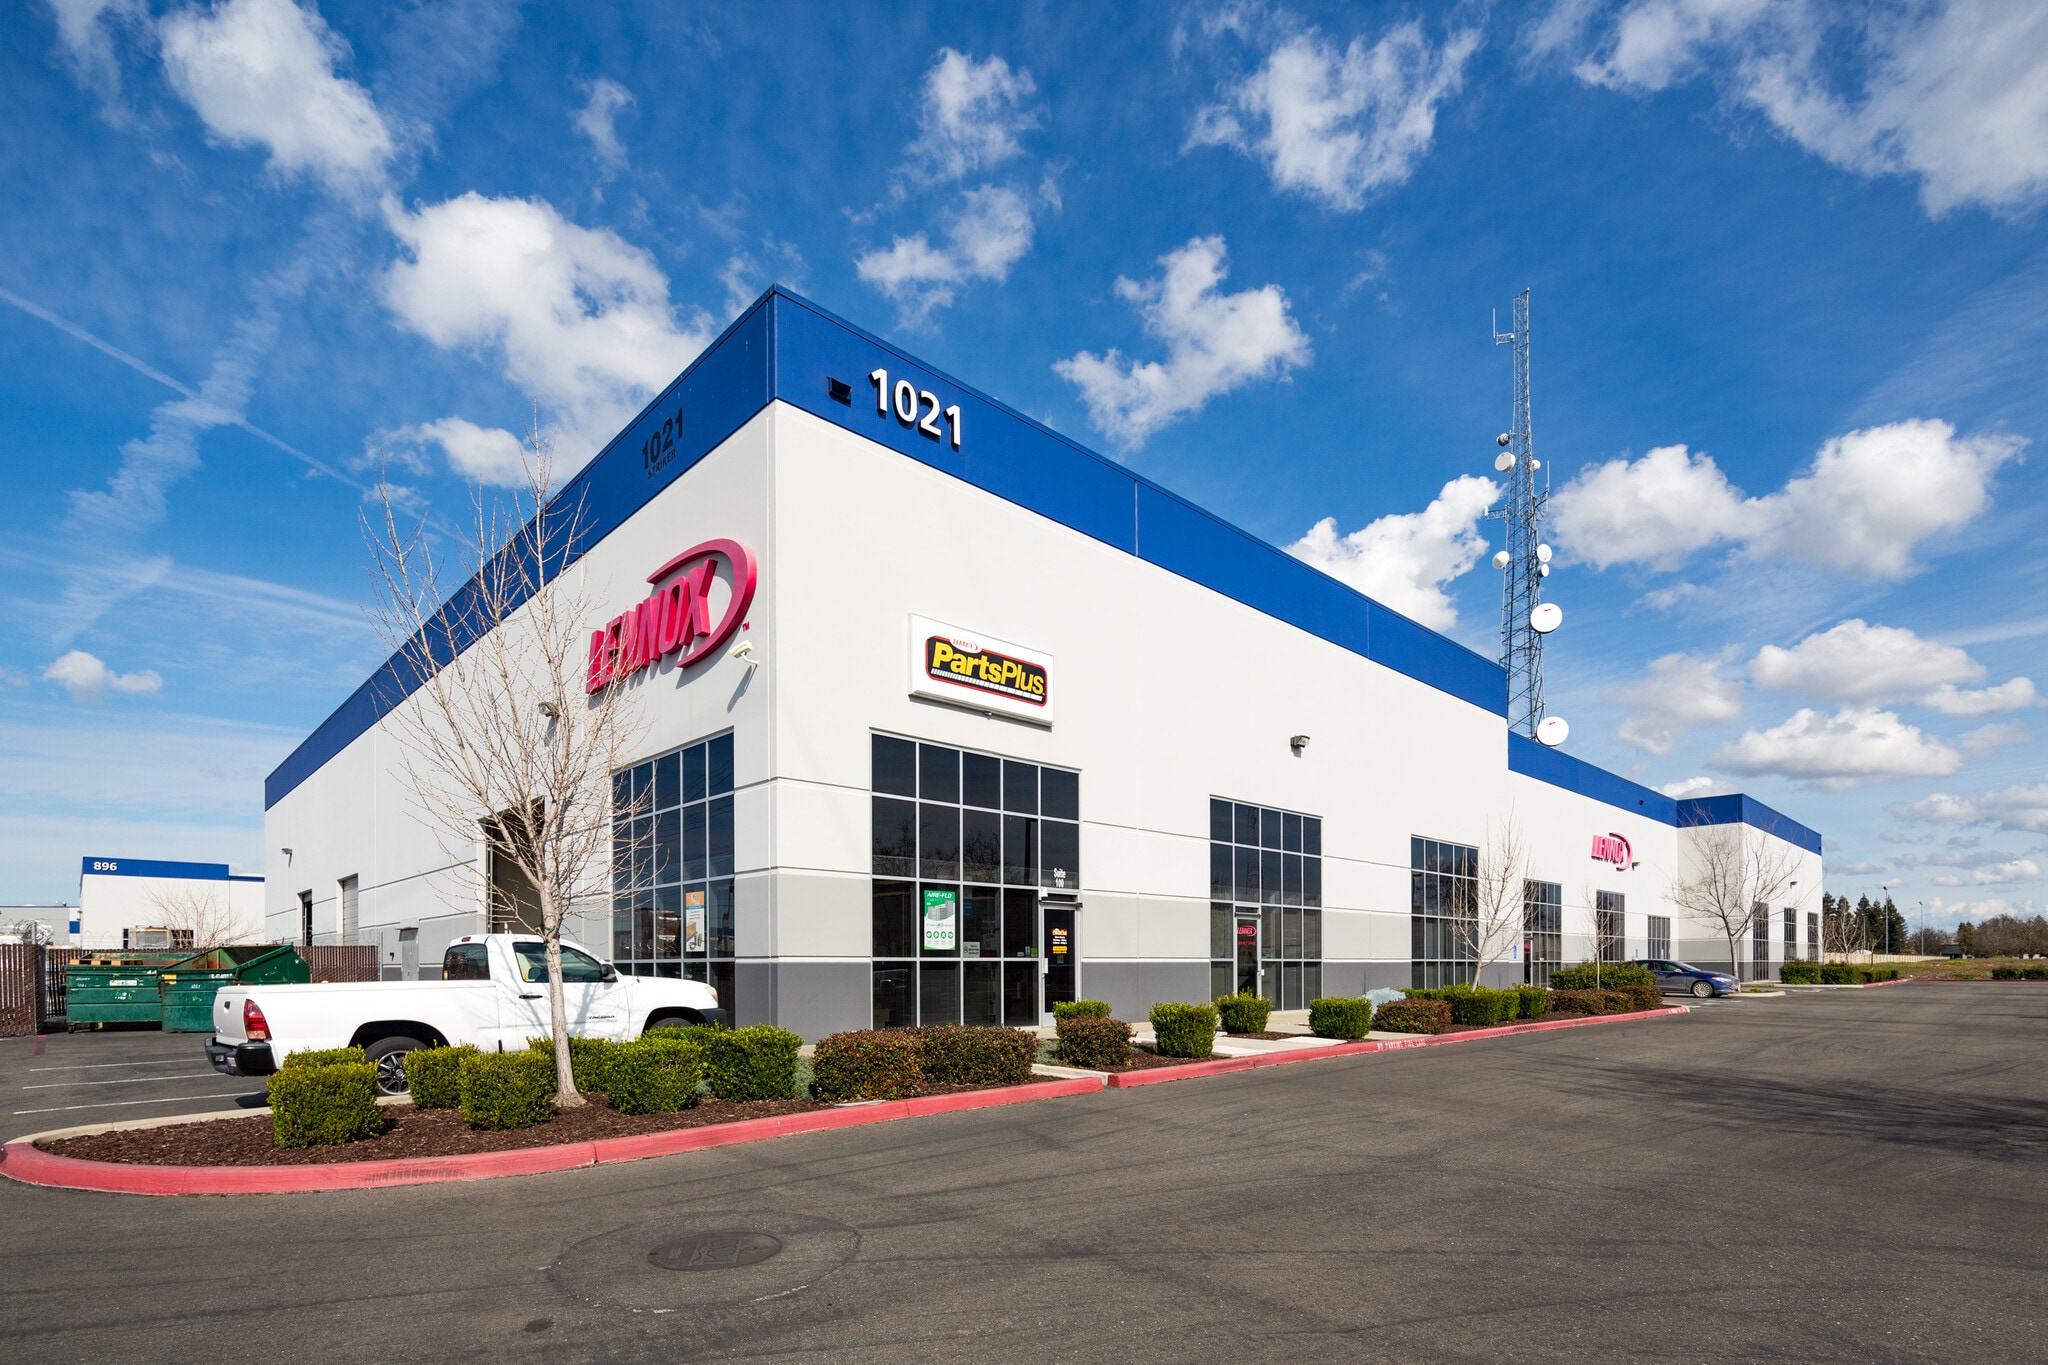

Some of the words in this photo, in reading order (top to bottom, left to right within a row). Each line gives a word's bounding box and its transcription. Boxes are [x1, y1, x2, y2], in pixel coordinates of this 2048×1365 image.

[869, 368, 961, 446] 1021
[642, 407, 683, 470] 1021
[647, 448, 677, 480] STRIKER
[585, 557, 719, 695] LENNOX
[932, 641, 1044, 695] PartsPlus
[1591, 833, 1630, 865] LENNOX
[93, 861, 118, 871] 896
[1053, 867, 1066, 878] Suite
[1055, 878, 1064, 888] 100
